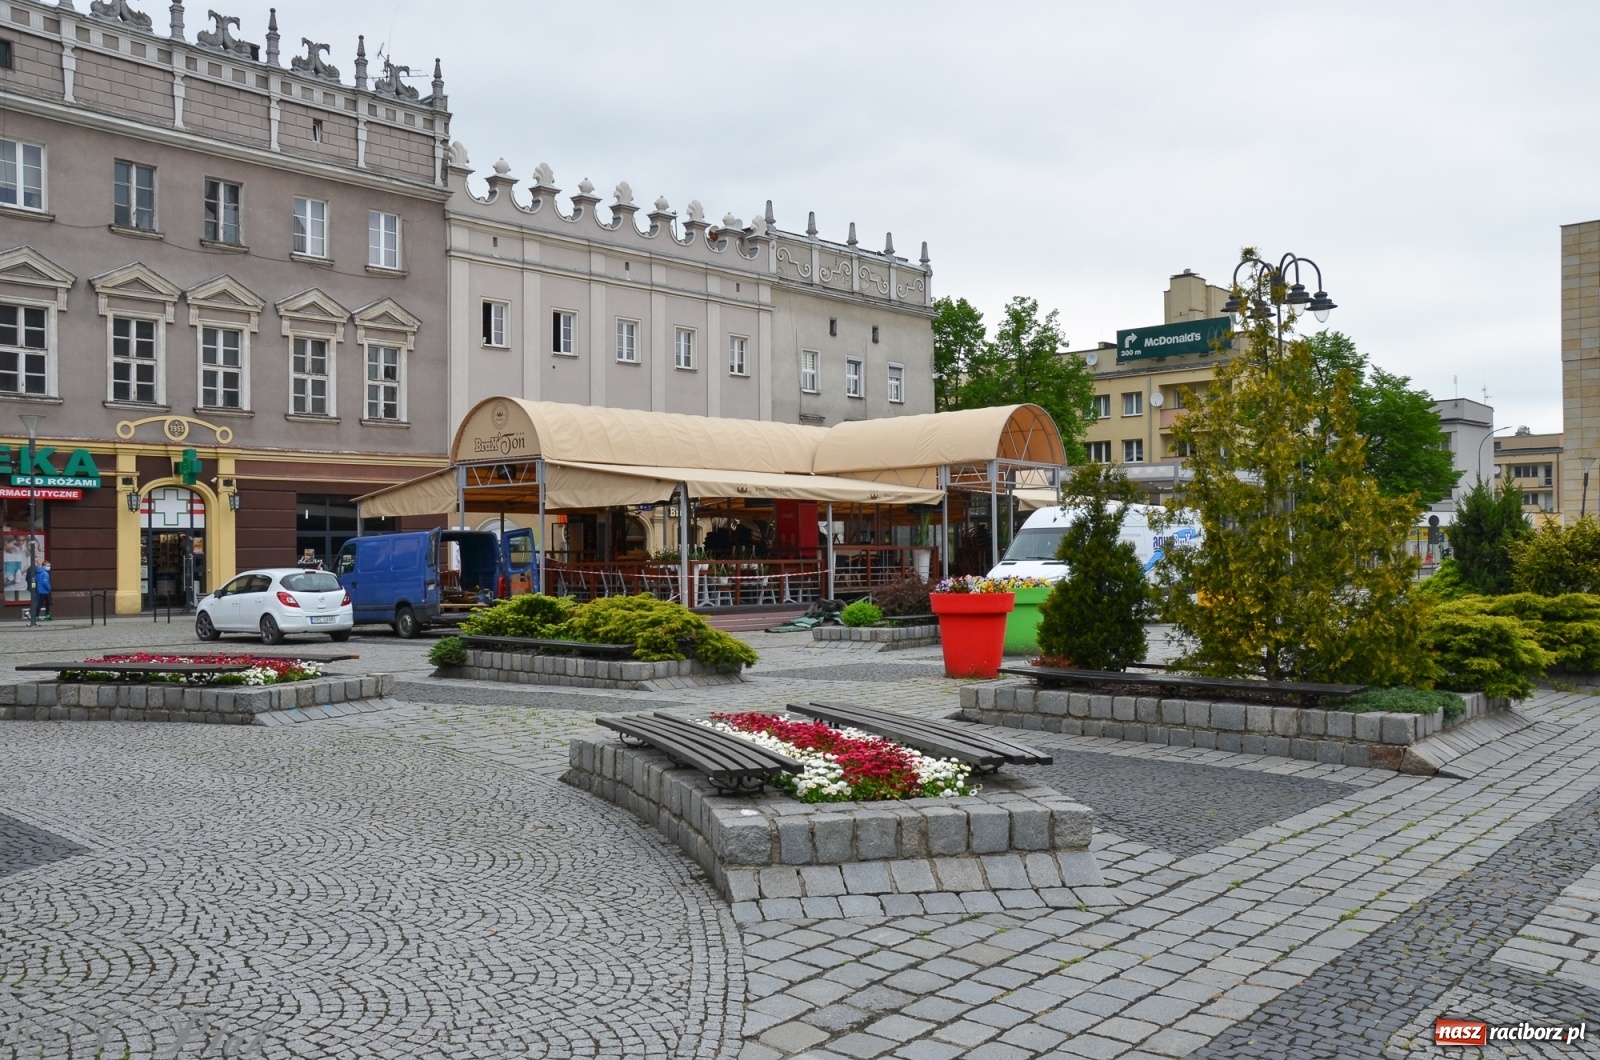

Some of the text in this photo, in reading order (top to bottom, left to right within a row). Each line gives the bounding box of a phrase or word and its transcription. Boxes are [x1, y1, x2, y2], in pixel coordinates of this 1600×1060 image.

[1144, 332, 1201, 347] McDonald's
[16, 477, 97, 487] POD RÓŻAMI
